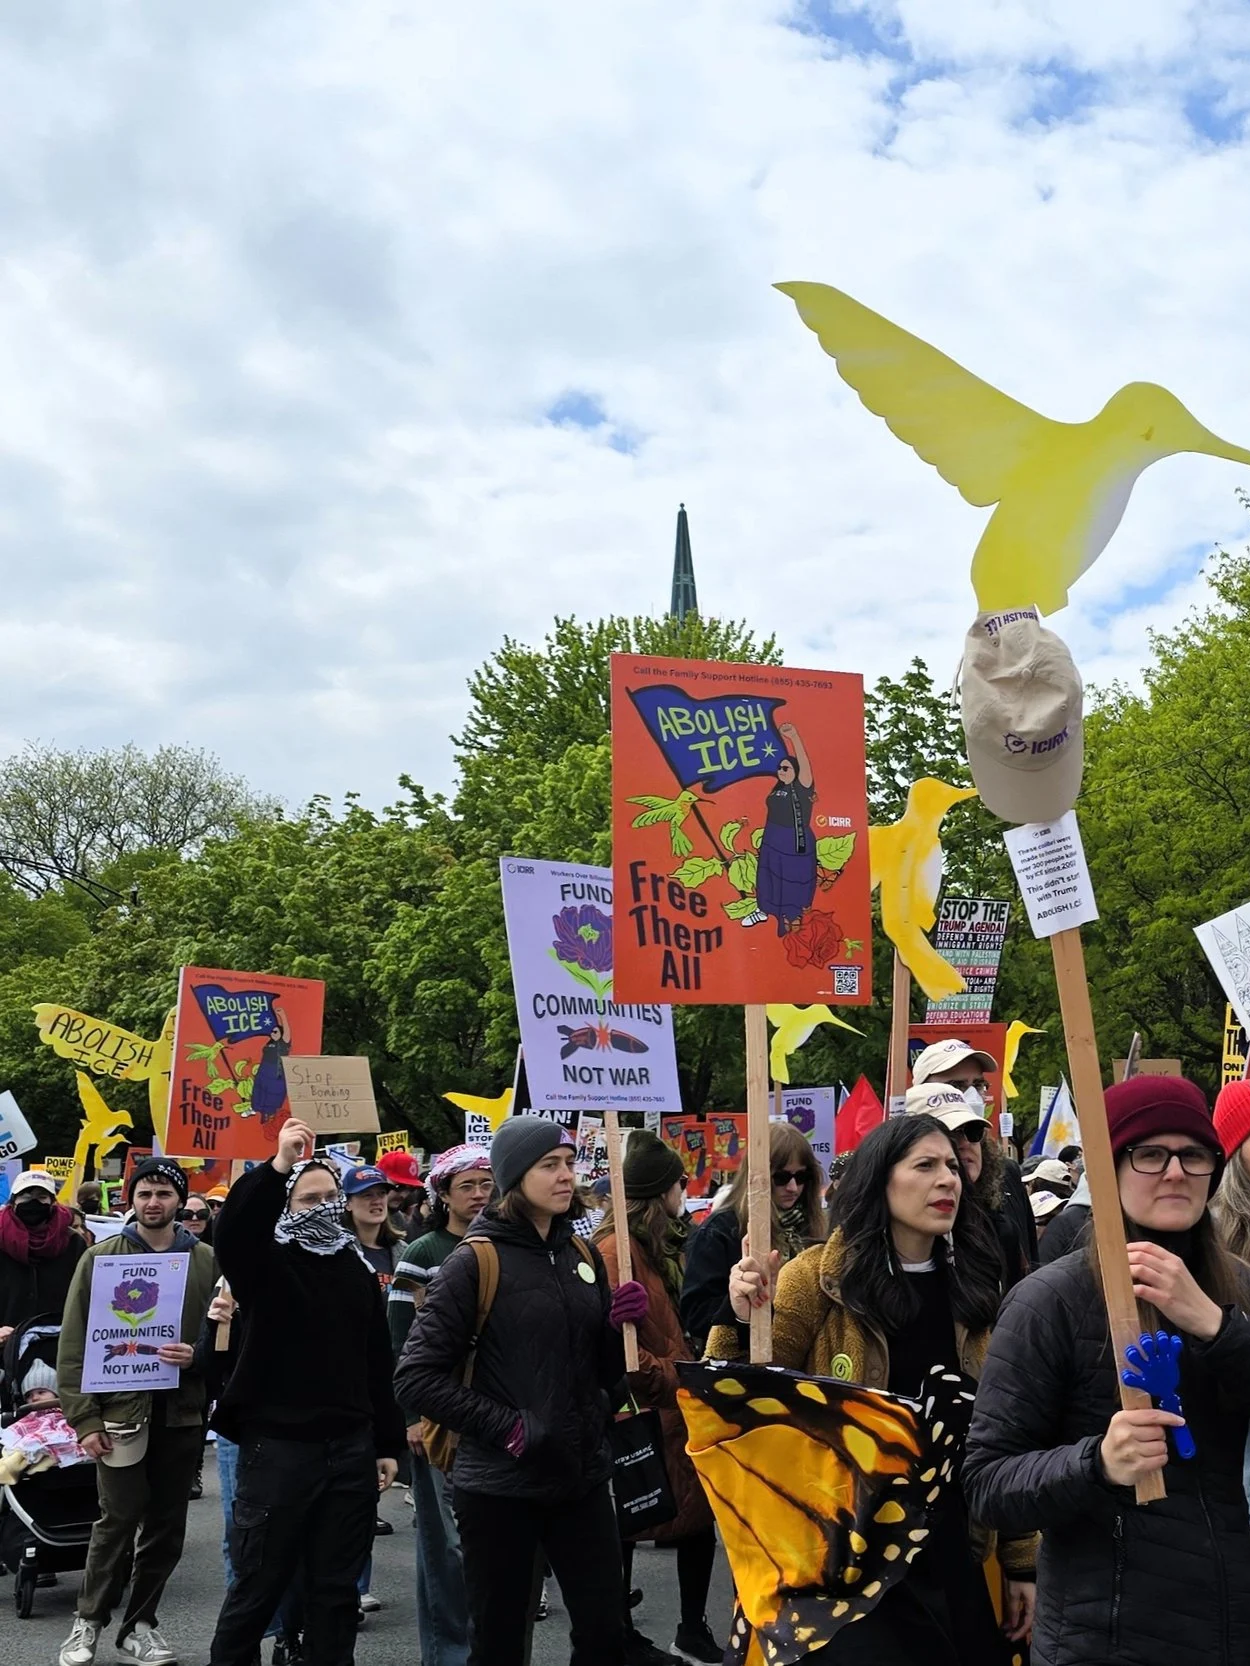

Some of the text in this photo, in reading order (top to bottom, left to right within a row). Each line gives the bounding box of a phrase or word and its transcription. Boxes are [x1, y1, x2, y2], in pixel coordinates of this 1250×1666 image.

[633, 665, 651, 676] Call
[653, 667, 667, 677] the
[669, 669, 698, 682] Family
[701, 672, 736, 684] Support
[739, 674, 769, 685] Hotline
[771, 675, 793, 688] (855)
[656, 703, 767, 742] ABOLISH
[688, 734, 760, 775] ICE
[828, 816, 851, 828] ICIRR
[1017, 866, 1031, 874] over
[1045, 856, 1065, 867] people
[1020, 855, 1038, 864] made
[517, 865, 535, 875] ICIRR
[560, 883, 613, 905] FUND
[629, 860, 707, 918] Free
[1027, 877, 1065, 894] This didn't
[1037, 885, 1078, 902] with Trump
[941, 900, 1008, 922] STOP THE
[1037, 903, 1069, 920] ABOLISH
[628, 905, 723, 954] Them
[939, 920, 1004, 933] TRUMP AGENDA!
[936, 941, 1003, 950] IMMIGRANT RIGHTS
[937, 933, 1005, 942] DEFEND & EXPAND
[661, 950, 702, 991] All
[206, 996, 268, 1015] ABOLISH
[533, 994, 662, 1025] COMMUNITIES
[222, 1013, 262, 1033] ICE
[49, 1012, 154, 1068] ABOLISH
[73, 1048, 129, 1078] ICE
[1223, 1063, 1240, 1071] ON
[292, 1066, 333, 1085] Stop
[562, 1064, 650, 1086] NOT WAR
[181, 1078, 224, 1112] Free
[310, 1086, 350, 1099] Bombing
[568, 1094, 586, 1102] Family
[587, 1094, 609, 1102] Support
[314, 1102, 351, 1119] KIDS
[786, 1097, 812, 1107] FUND
[179, 1103, 231, 1131] Them
[468, 1124, 492, 1133] ICE
[192, 1127, 216, 1151] All
[379, 1134, 394, 1147] VETS
[46, 1158, 76, 1169] POWE
[122, 1267, 157, 1279] FUND
[92, 1325, 175, 1342] COMMUNITIES
[102, 1362, 160, 1375] NOT WAR
